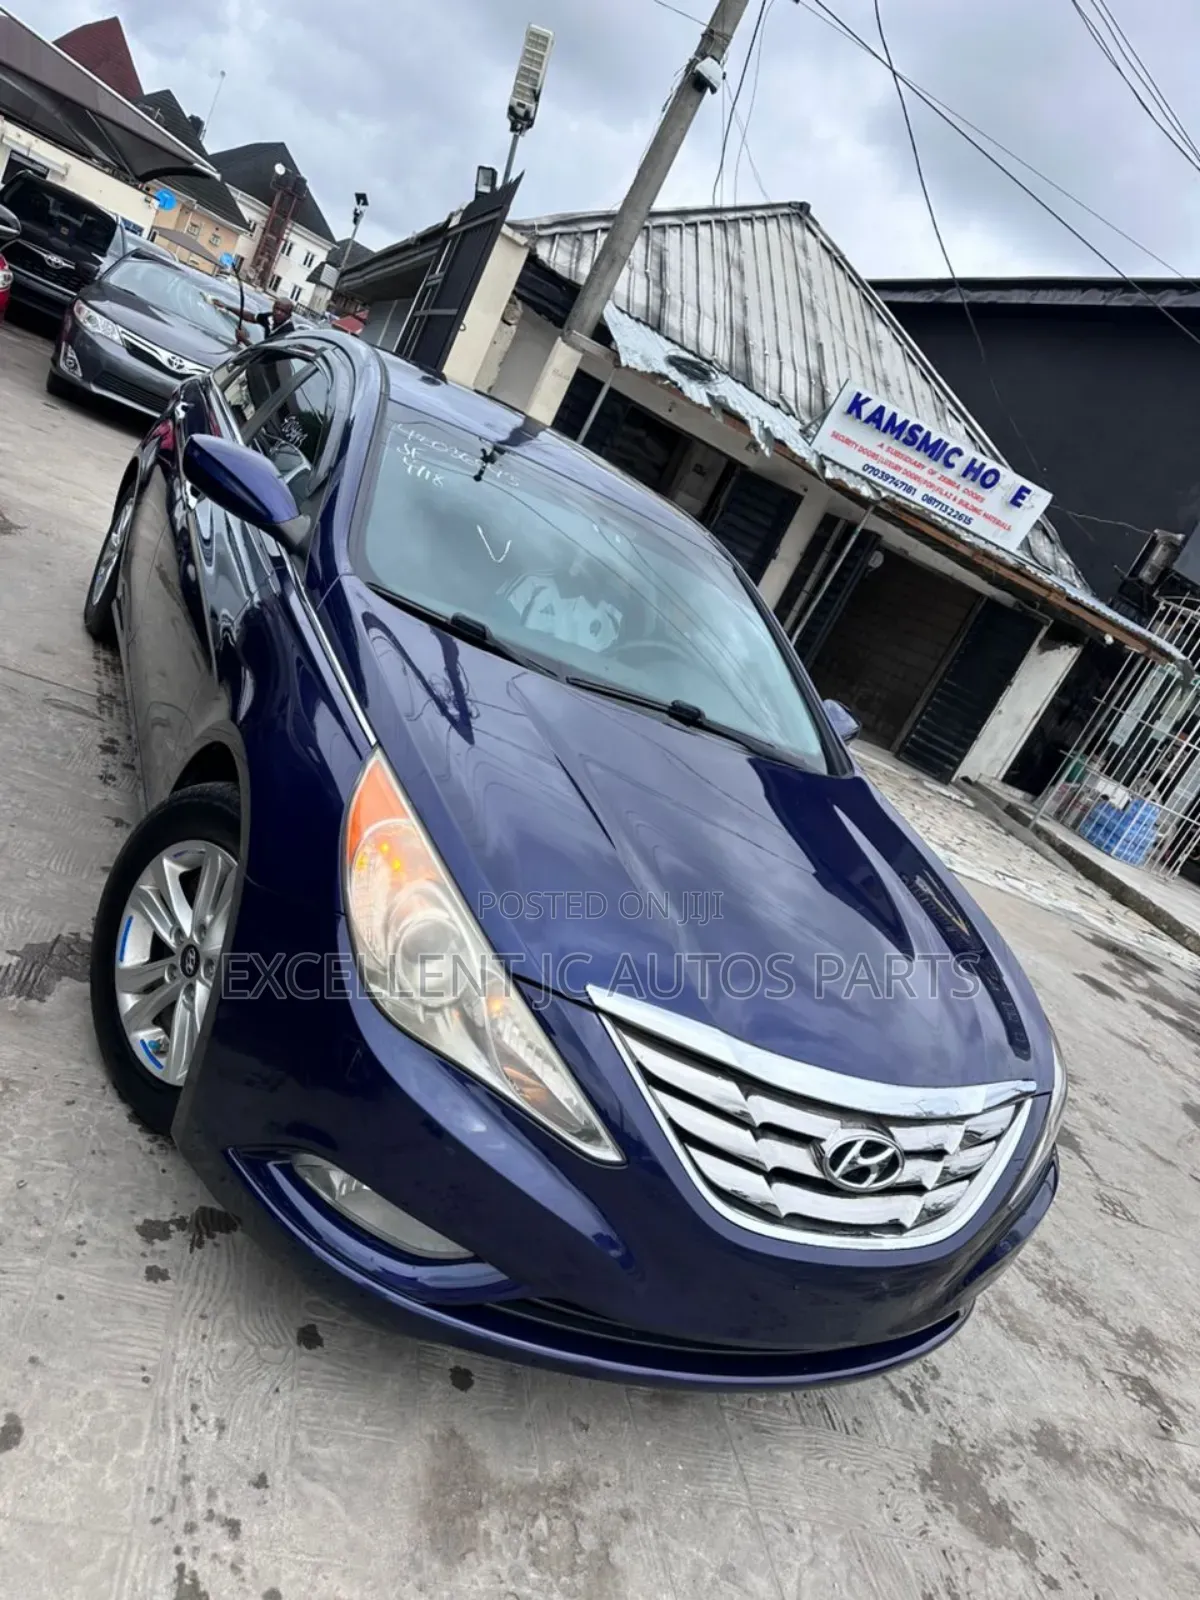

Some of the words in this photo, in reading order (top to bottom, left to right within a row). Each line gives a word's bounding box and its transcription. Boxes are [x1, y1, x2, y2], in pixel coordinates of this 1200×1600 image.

[846, 392, 963, 469] KAMSMIC
[830, 430, 859, 450] SECURITY
[957, 498, 983, 516] BUILDING
[981, 511, 1012, 532] MATERIALS
[862, 464, 916, 495] 07039747181
[886, 446, 925, 471] SUBSIDIARY
[927, 467, 937, 477] OF
[937, 473, 962, 490] ZEBRA
[962, 488, 986, 504] DOORS
